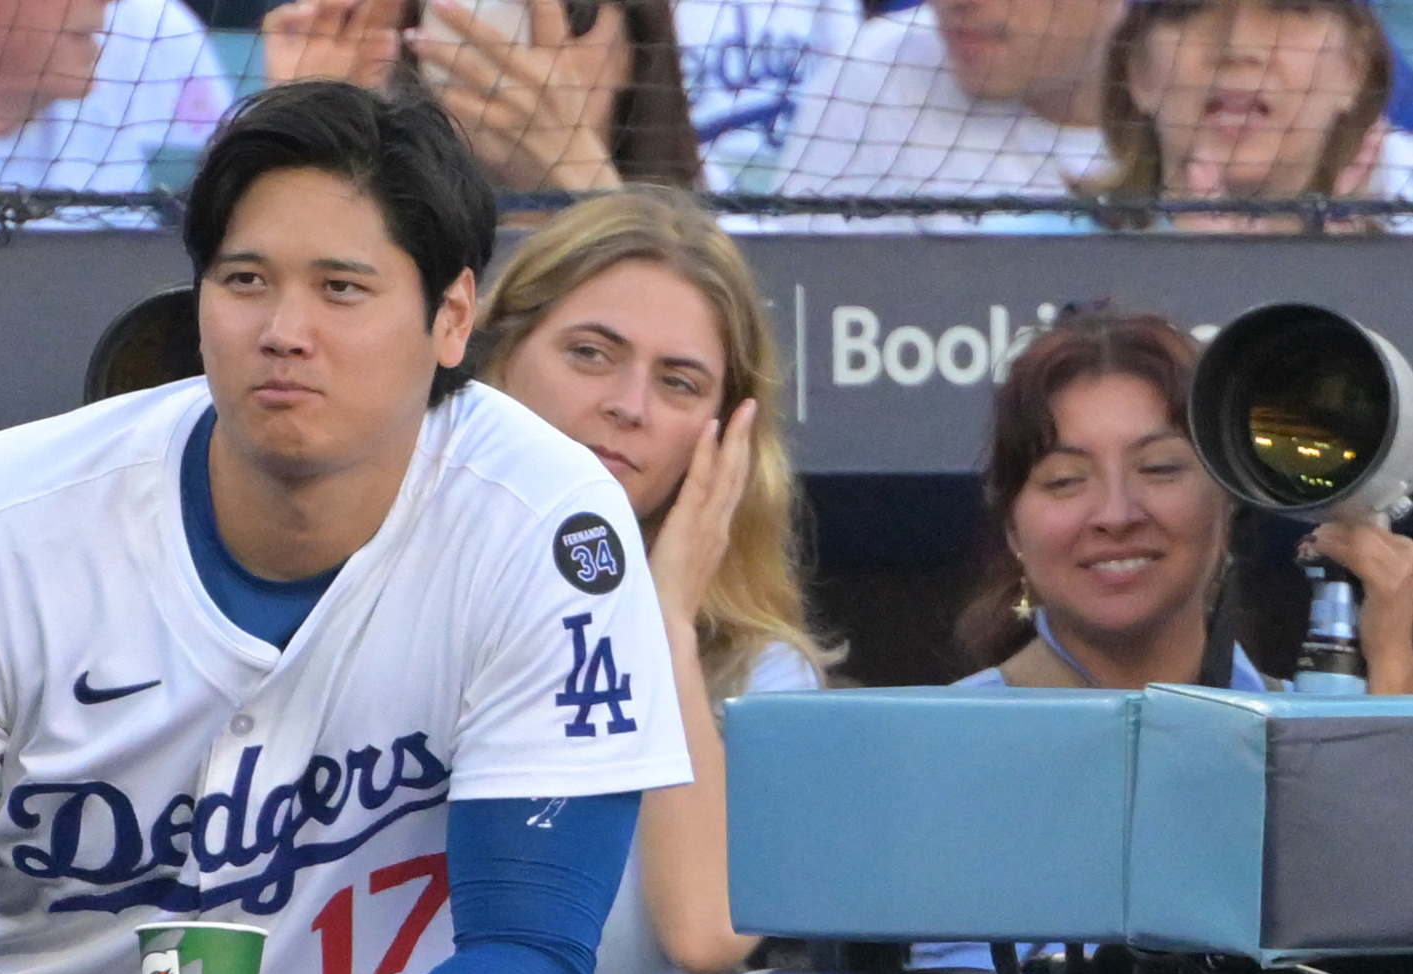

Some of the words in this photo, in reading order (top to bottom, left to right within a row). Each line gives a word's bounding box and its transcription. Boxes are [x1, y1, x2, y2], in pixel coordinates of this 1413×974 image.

[832, 303, 1058, 386] Book
[561, 525, 607, 546] FERNANDO
[570, 539, 617, 582] 34
[555, 612, 637, 737] LA
[8, 731, 451, 914] Dodgers
